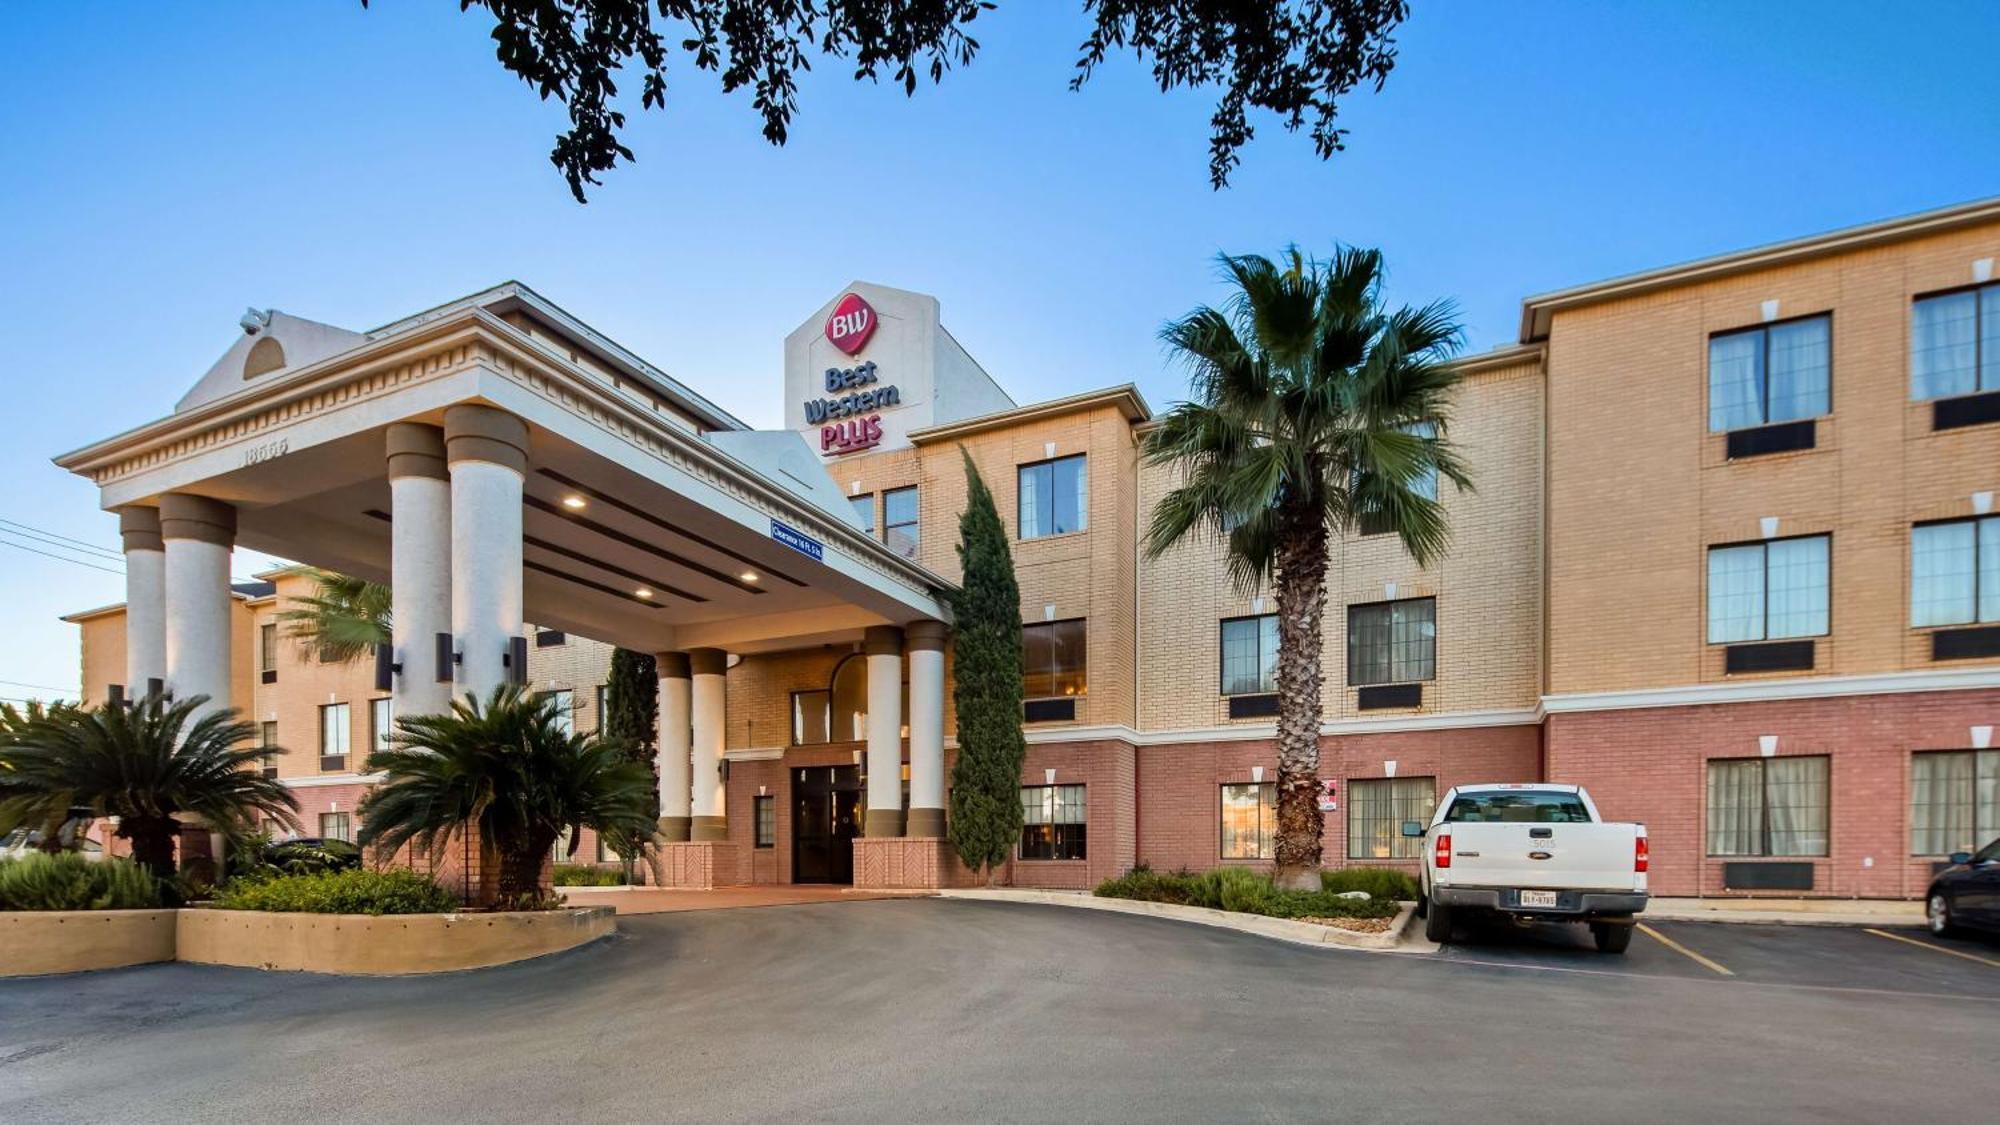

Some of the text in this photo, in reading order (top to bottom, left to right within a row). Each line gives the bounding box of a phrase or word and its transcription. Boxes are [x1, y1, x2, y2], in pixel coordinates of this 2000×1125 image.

[832, 308, 868, 339] BW
[825, 360, 878, 393] Best
[804, 384, 901, 425] Western
[821, 414, 883, 451] PLUS
